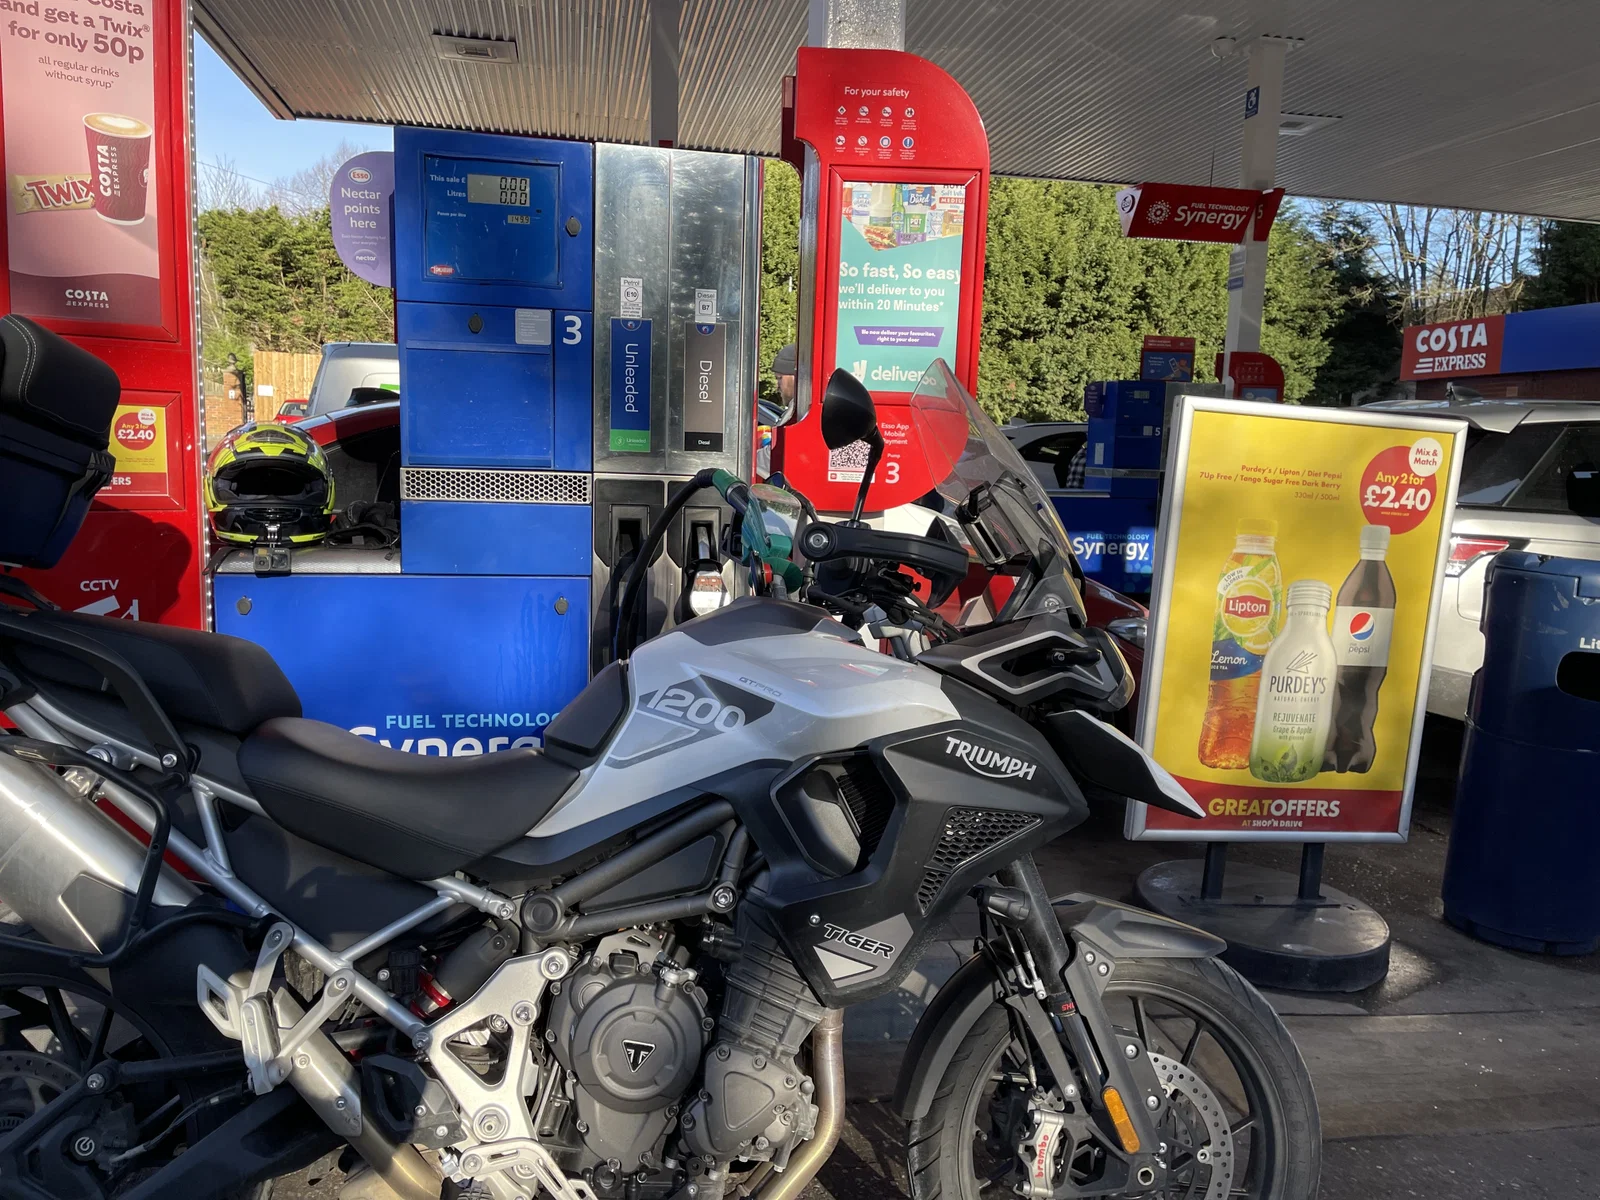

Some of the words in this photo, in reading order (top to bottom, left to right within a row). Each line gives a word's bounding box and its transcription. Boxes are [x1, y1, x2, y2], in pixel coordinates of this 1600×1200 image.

[0, 0, 39, 16] and
[44, 7, 79, 23] get
[83, 16, 95, 28] a
[8, 20, 40, 40] for
[44, 32, 88, 53] only
[93, 33, 144, 64] 50p
[38, 56, 51, 65] all
[53, 59, 88, 71] regular
[90, 65, 120, 78] drinks
[45, 69, 83, 83] without
[844, 86, 859, 95] For
[861, 88, 881, 98] your
[882, 88, 910, 99] safety
[97, 145, 112, 197] COSTA
[111, 146, 121, 187] EXPRESS
[352, 171, 369, 180] Esso
[430, 174, 445, 182] This
[500, 176, 528, 191] 0.00
[25, 176, 95, 208] Twix
[341, 187, 381, 200] Nectar
[447, 190, 466, 198] Litres
[500, 191, 528, 205] 0.00
[344, 203, 381, 216] points
[1191, 202, 1206, 210] FUEL
[1208, 203, 1250, 212] TECHNOLOGY
[350, 217, 377, 228] here
[1174, 205, 1247, 230] Synergy
[1257, 204, 1264, 220] 5
[840, 261, 859, 277] So
[863, 262, 899, 280] fast,
[902, 263, 922, 279] So
[926, 268, 960, 285] easy
[623, 279, 640, 287] Petrol
[65, 289, 109, 301] COSTA
[626, 290, 638, 298] E10
[839, 283, 864, 294] we'll
[867, 284, 907, 296] deliver
[909, 286, 922, 296] to
[923, 288, 945, 299] you
[73, 301, 110, 309] EXPRESS
[838, 299, 874, 310] within
[877, 299, 891, 310] 20
[562, 315, 582, 345] 3
[1416, 323, 1488, 353] COSTA
[1434, 353, 1486, 372] EXPRESS
[625, 343, 639, 412] Unleaded
[699, 360, 712, 403] Diesel
[896, 423, 909, 431] App
[1155, 427, 1161, 436] 5
[118, 429, 154, 440] £2.40
[1415, 448, 1431, 456] Mix
[1431, 449, 1438, 457] &
[1414, 457, 1437, 466] Match
[885, 462, 900, 484] 3
[1241, 465, 1272, 475] Purdey's
[1279, 468, 1300, 476] Lipton
[1323, 471, 1342, 479] Pepsi
[1375, 471, 1399, 487] Any
[1400, 473, 1408, 484] 2
[1408, 473, 1425, 486] for
[1199, 472, 1214, 480] 7Up
[1240, 475, 1261, 484] Tango
[1263, 476, 1284, 485] Sugar
[1285, 478, 1300, 486] Free
[1302, 479, 1319, 487] Dark
[1321, 481, 1341, 490] Berry
[1364, 485, 1432, 511] £2.40
[1072, 536, 1149, 560] Synergy
[1224, 571, 1237, 582] LOW
[80, 579, 119, 591] CCTV
[1229, 600, 1266, 614] Lipton
[1348, 646, 1370, 654] pepsi
[1210, 650, 1248, 665] Lemon
[1269, 675, 1327, 694] PURDEY'S
[646, 688, 745, 733] 1200
[1272, 712, 1316, 722] REJUVENATE
[386, 715, 436, 729] FUEL
[1272, 725, 1290, 734] Grape
[1296, 726, 1313, 734] Apple
[945, 736, 1037, 780] TRIUMPH
[824, 922, 895, 959] TIGER
[1035, 1134, 1049, 1178] brembo
